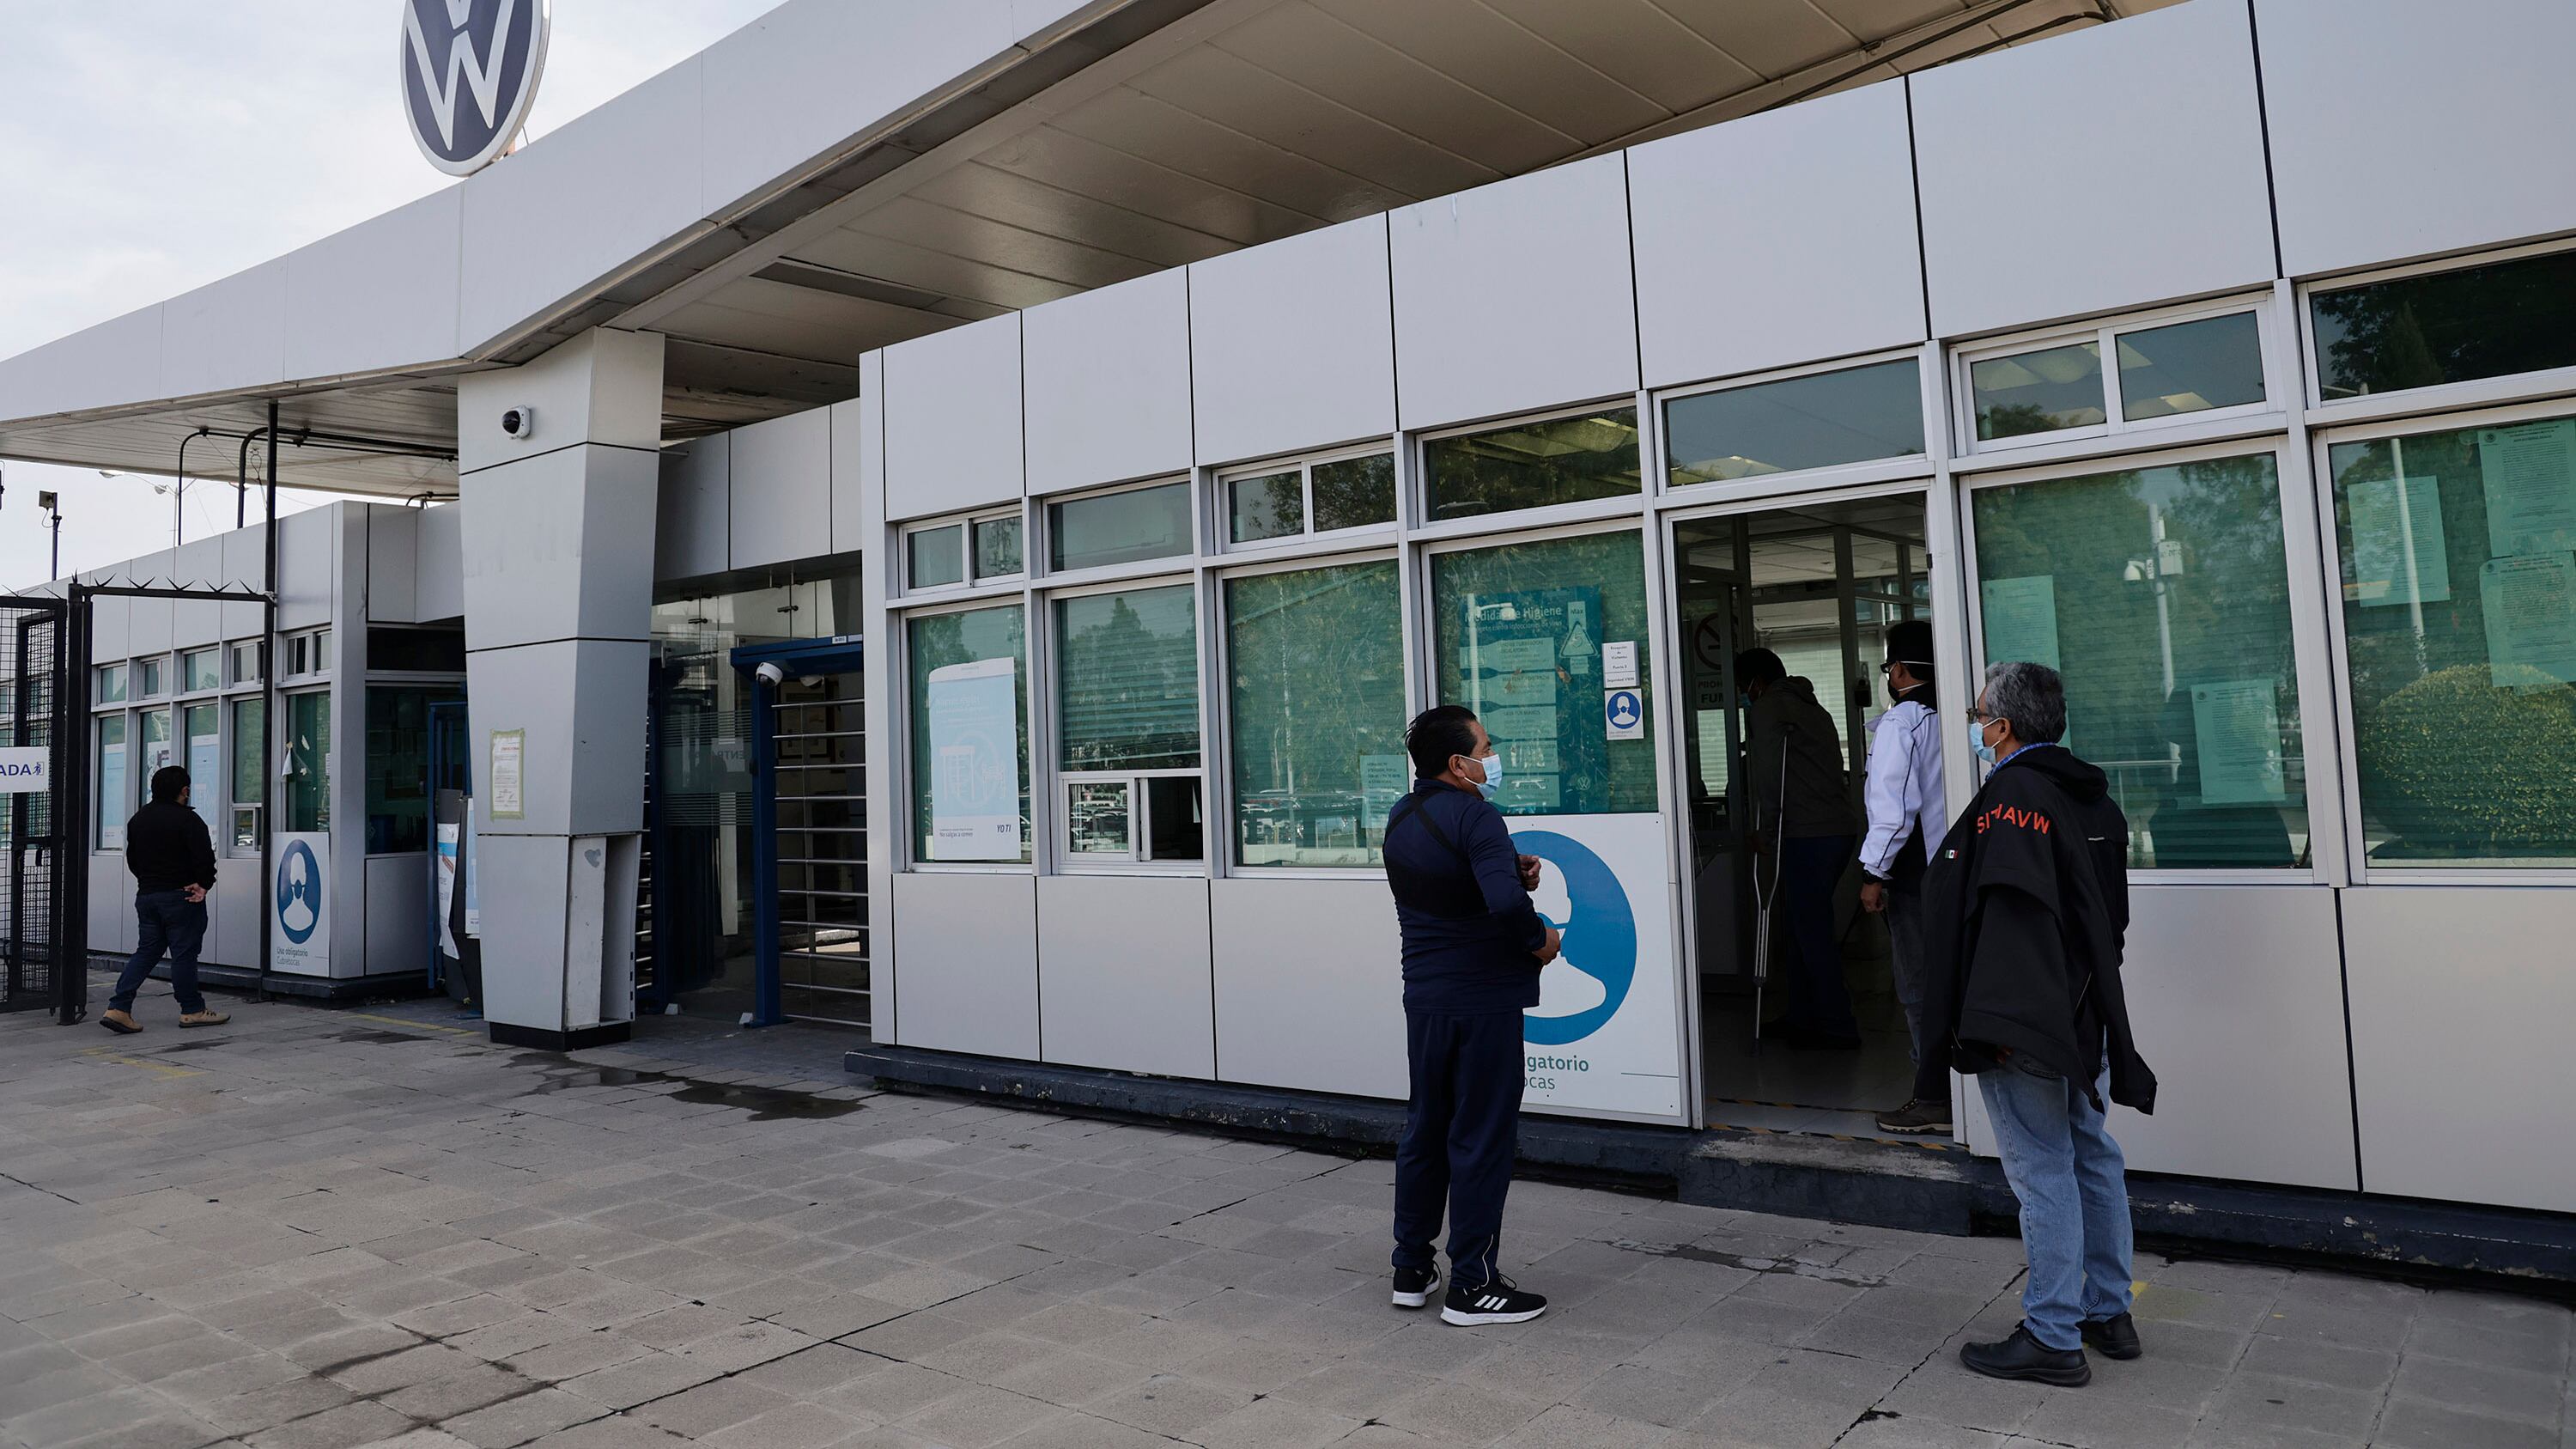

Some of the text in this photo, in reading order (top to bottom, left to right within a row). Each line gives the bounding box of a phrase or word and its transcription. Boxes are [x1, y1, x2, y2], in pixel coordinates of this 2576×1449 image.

[1522, 606, 1562, 622] Higiene
[0, 764, 32, 776] ADA
[1527, 1055, 1589, 1073] gatorio
